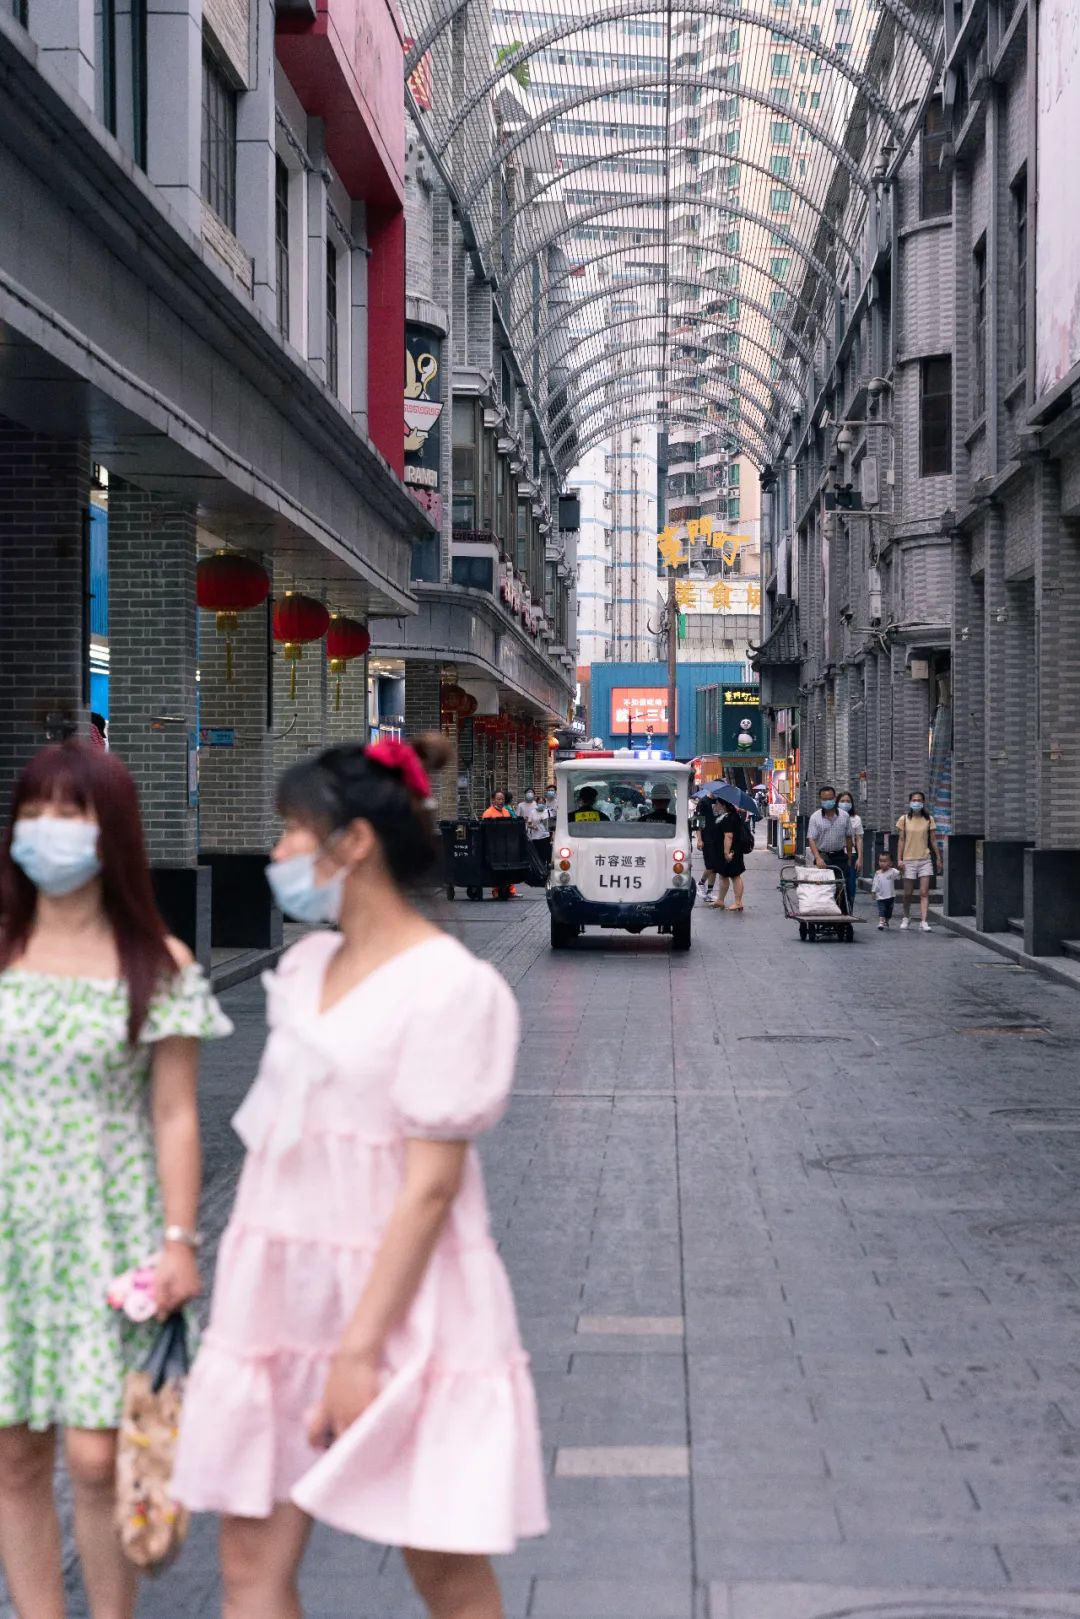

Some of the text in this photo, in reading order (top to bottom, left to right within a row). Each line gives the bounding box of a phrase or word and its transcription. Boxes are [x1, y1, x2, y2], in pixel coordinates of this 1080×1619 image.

[595, 854, 646, 872] 市容巡查
[600, 874, 642, 890] LH15
